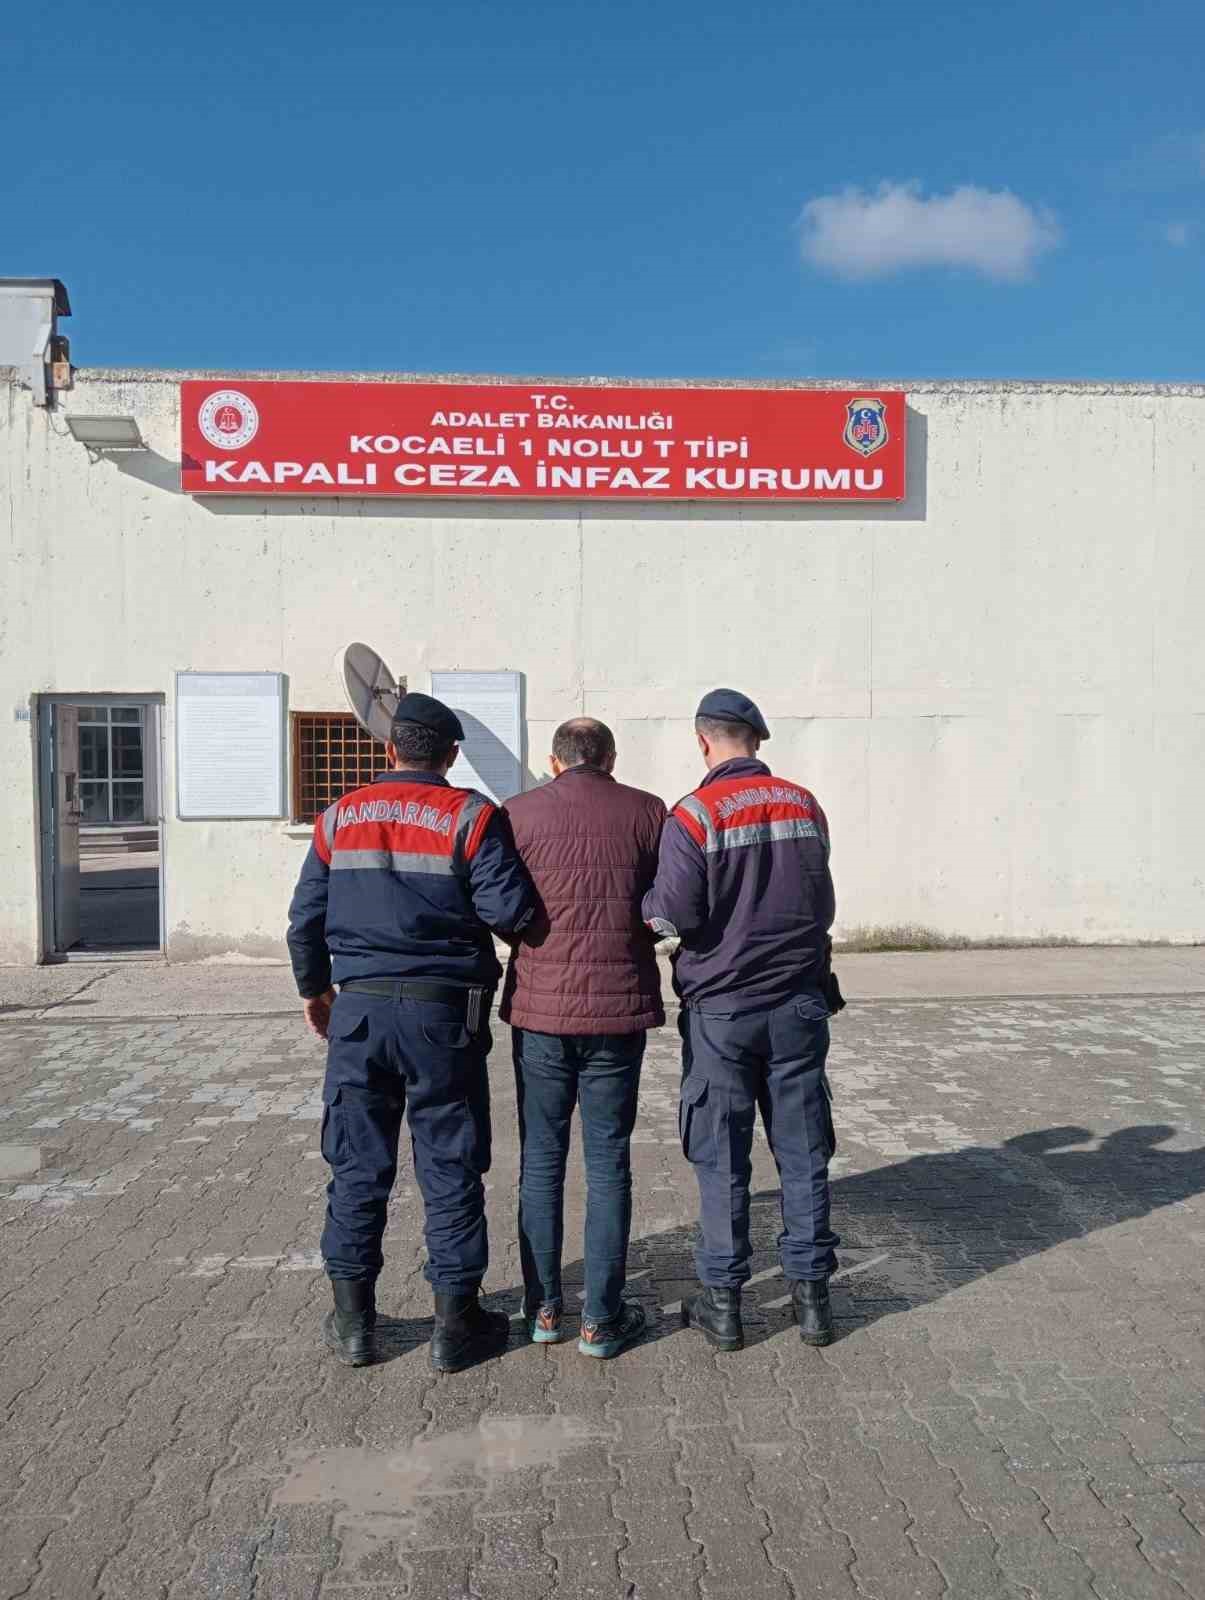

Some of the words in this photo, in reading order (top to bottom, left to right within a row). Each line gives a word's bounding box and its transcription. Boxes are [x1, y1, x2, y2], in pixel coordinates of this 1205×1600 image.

[531, 394, 575, 411] T.C.
[431, 411, 531, 428] ADALET
[536, 411, 673, 430] BAKANLIĞI
[349, 433, 506, 456] KOCAELİ
[519, 438, 532, 456] 1
[547, 438, 643, 458] NOLU
[653, 440, 675, 458] T
[683, 435, 748, 459] TİPİ
[205, 460, 377, 485] KAPALI
[393, 464, 521, 488] CEZA
[536, 459, 670, 489] İNFAZ
[685, 468, 883, 491] KURUMU
